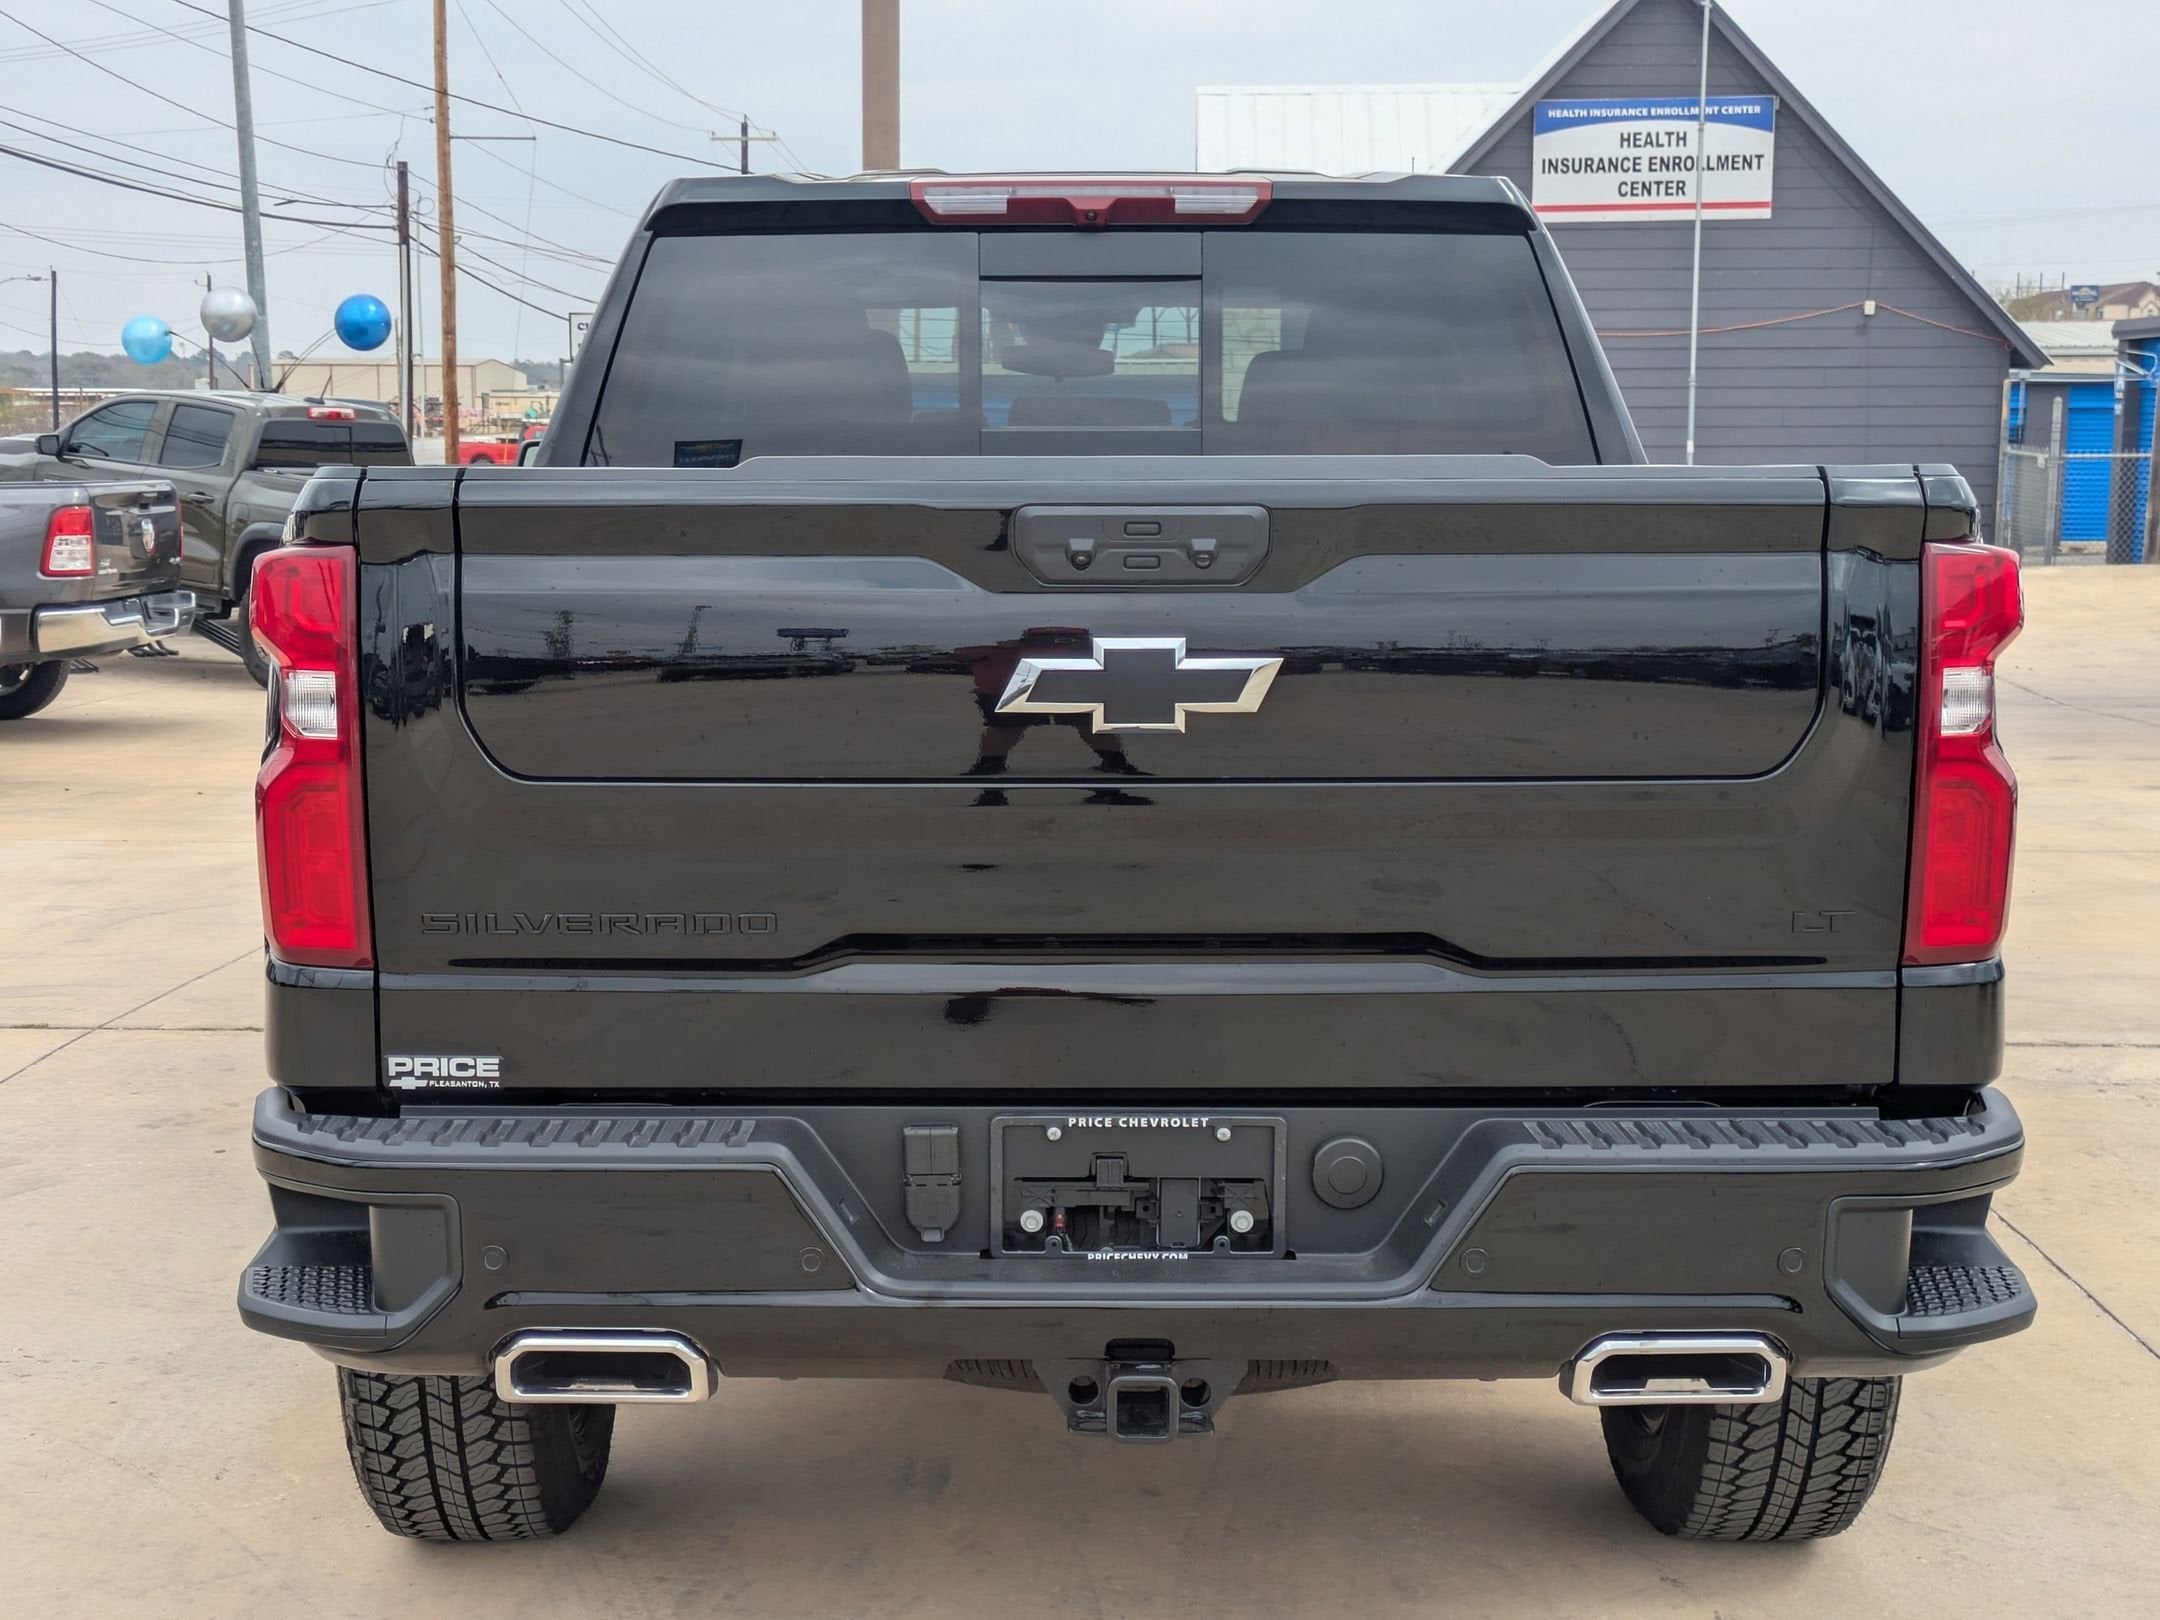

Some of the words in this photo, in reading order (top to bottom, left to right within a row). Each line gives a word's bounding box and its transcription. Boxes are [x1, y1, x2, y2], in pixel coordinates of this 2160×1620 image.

[1548, 109, 1587, 118] HEALTH
[1590, 107, 1648, 117] INSURANCE
[1651, 106, 1719, 116] ENROLLMNT
[1721, 105, 1761, 115] CENTER
[1620, 131, 1688, 149] HEALTH
[1541, 156, 1642, 175] INSURANCE
[1618, 180, 1687, 198] CENTER
[421, 912, 779, 936] SILVERADO
[1792, 911, 1856, 933] LT
[388, 1057, 500, 1077] PRICE
[429, 1080, 487, 1089] PLEASANTON,
[1068, 1117, 1113, 1128] PRICE
[1118, 1117, 1209, 1128] CHEVROLET
[1087, 1252, 1188, 1261] PRICECHEVYCOM
